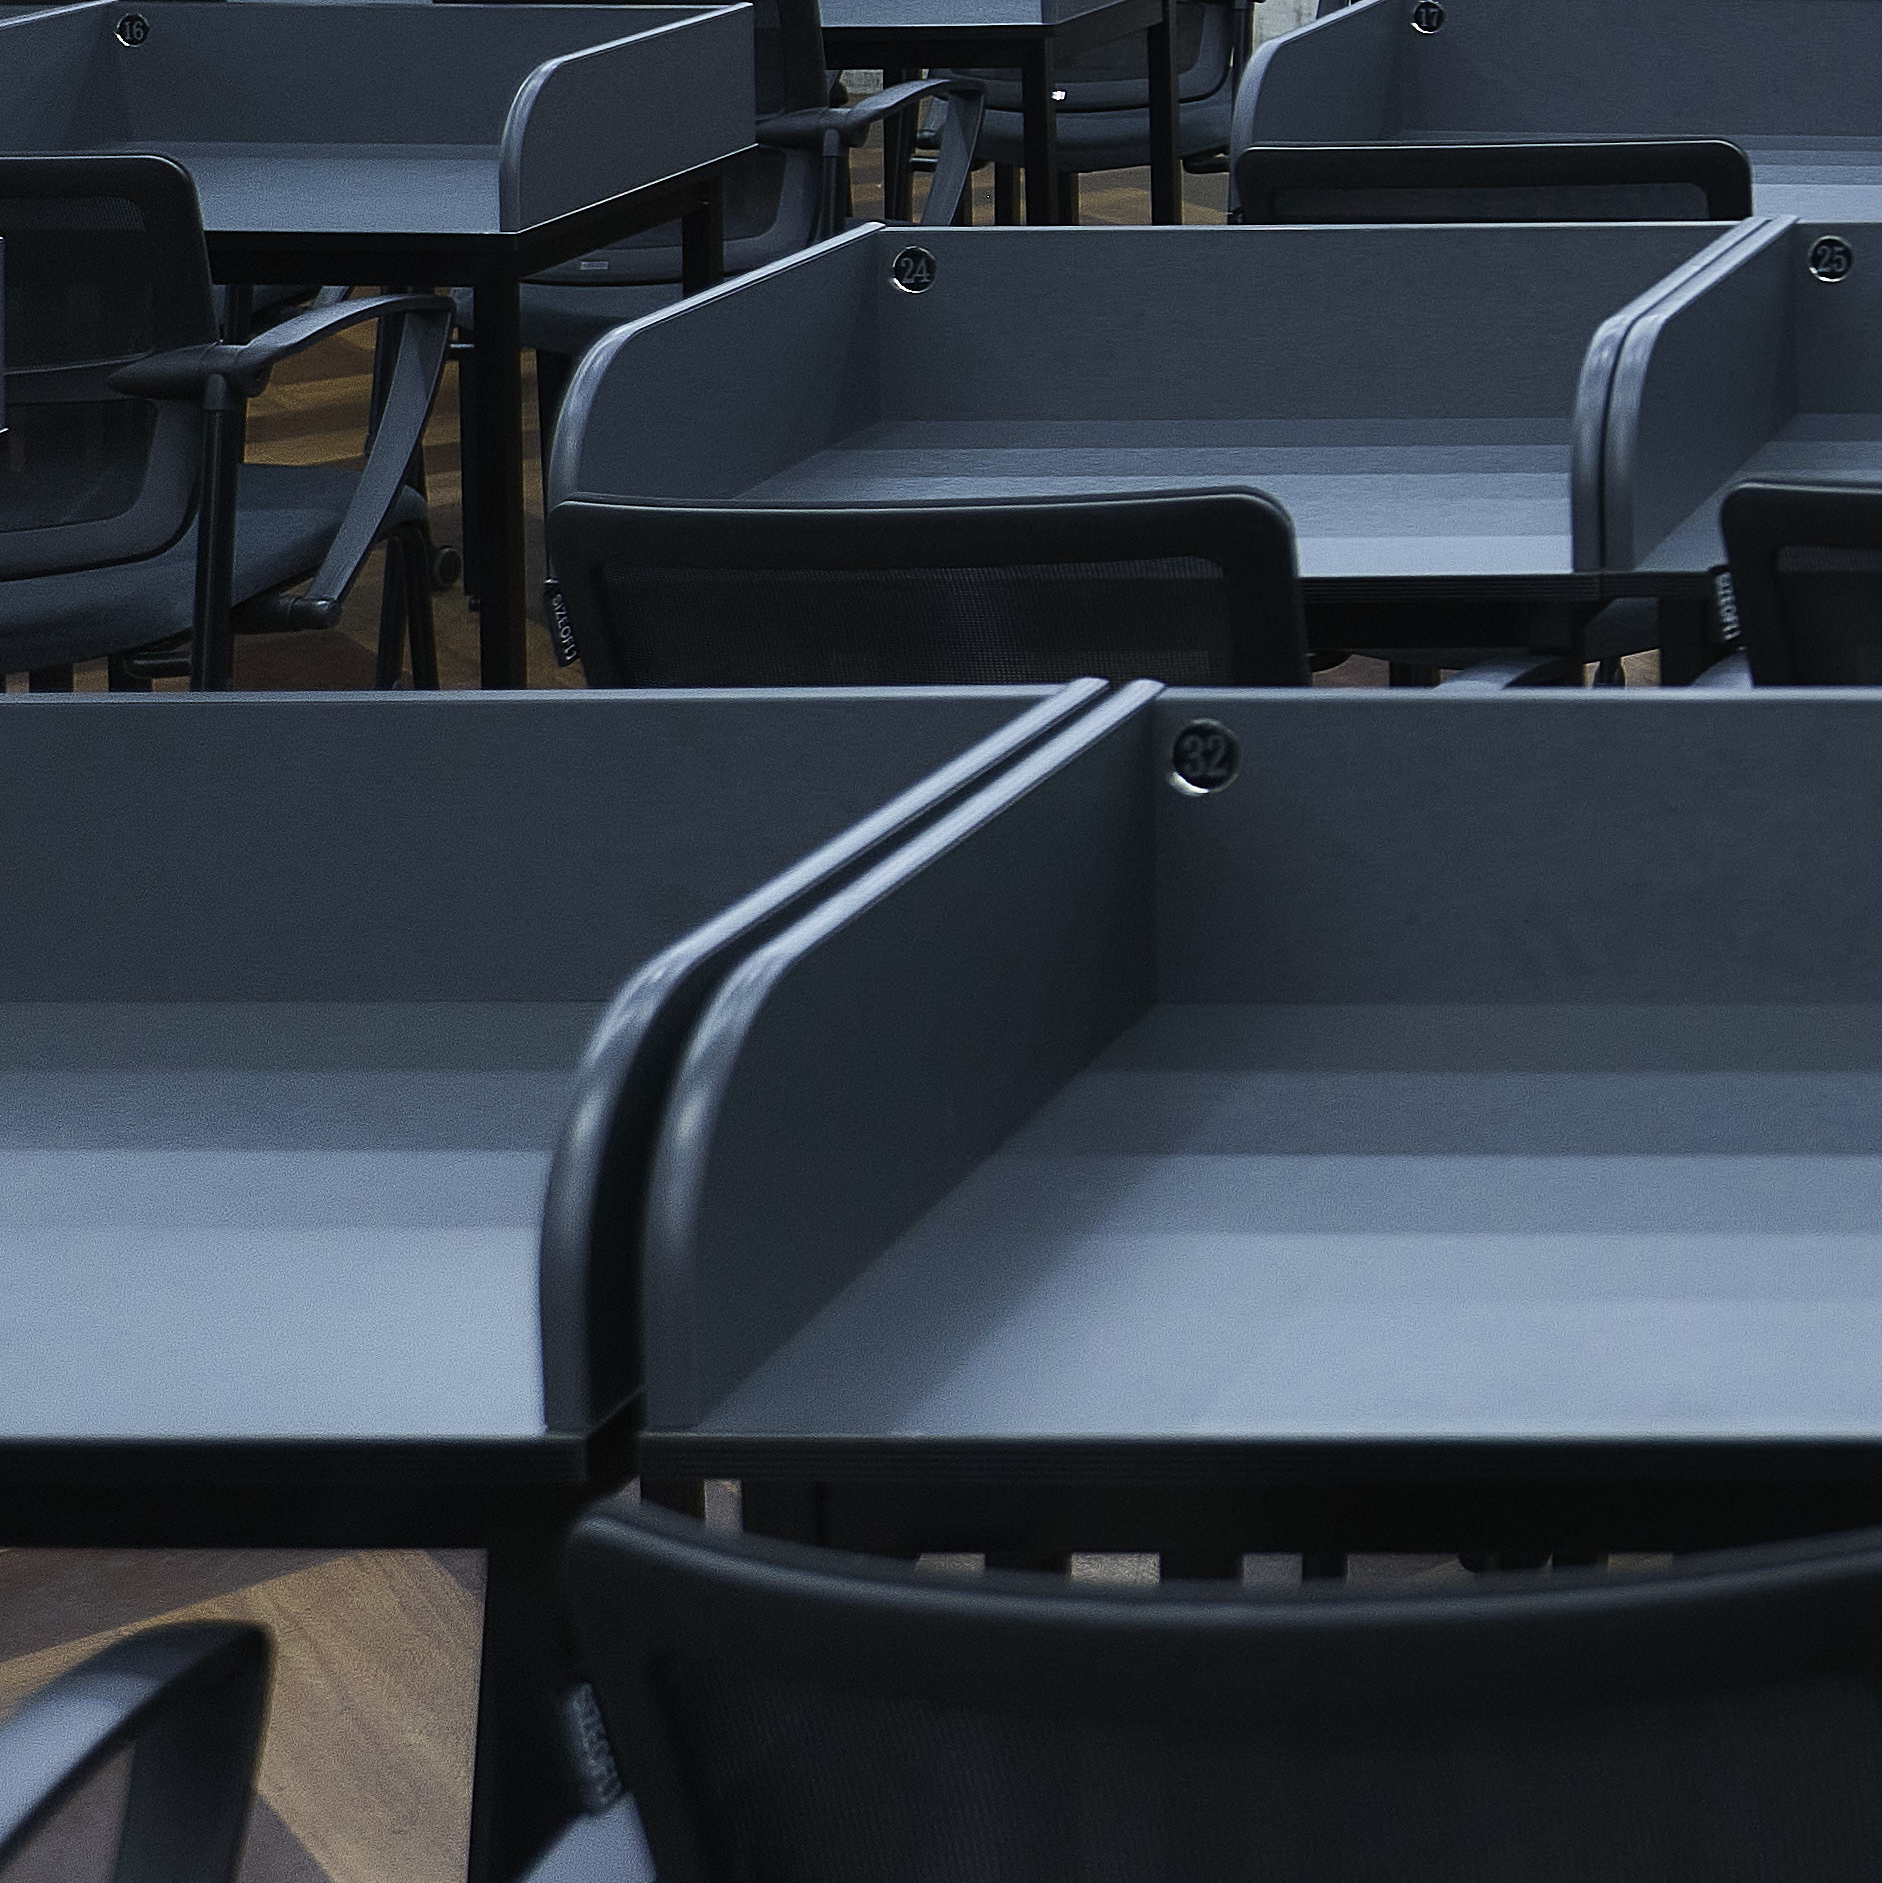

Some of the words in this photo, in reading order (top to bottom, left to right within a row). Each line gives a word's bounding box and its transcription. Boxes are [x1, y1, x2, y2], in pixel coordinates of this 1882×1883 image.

[123, 20, 144, 40] 16
[1418, 7, 1439, 27] 17
[902, 258, 930, 284] 24
[1816, 246, 1845, 272] 25
[1184, 734, 1228, 777] 32
